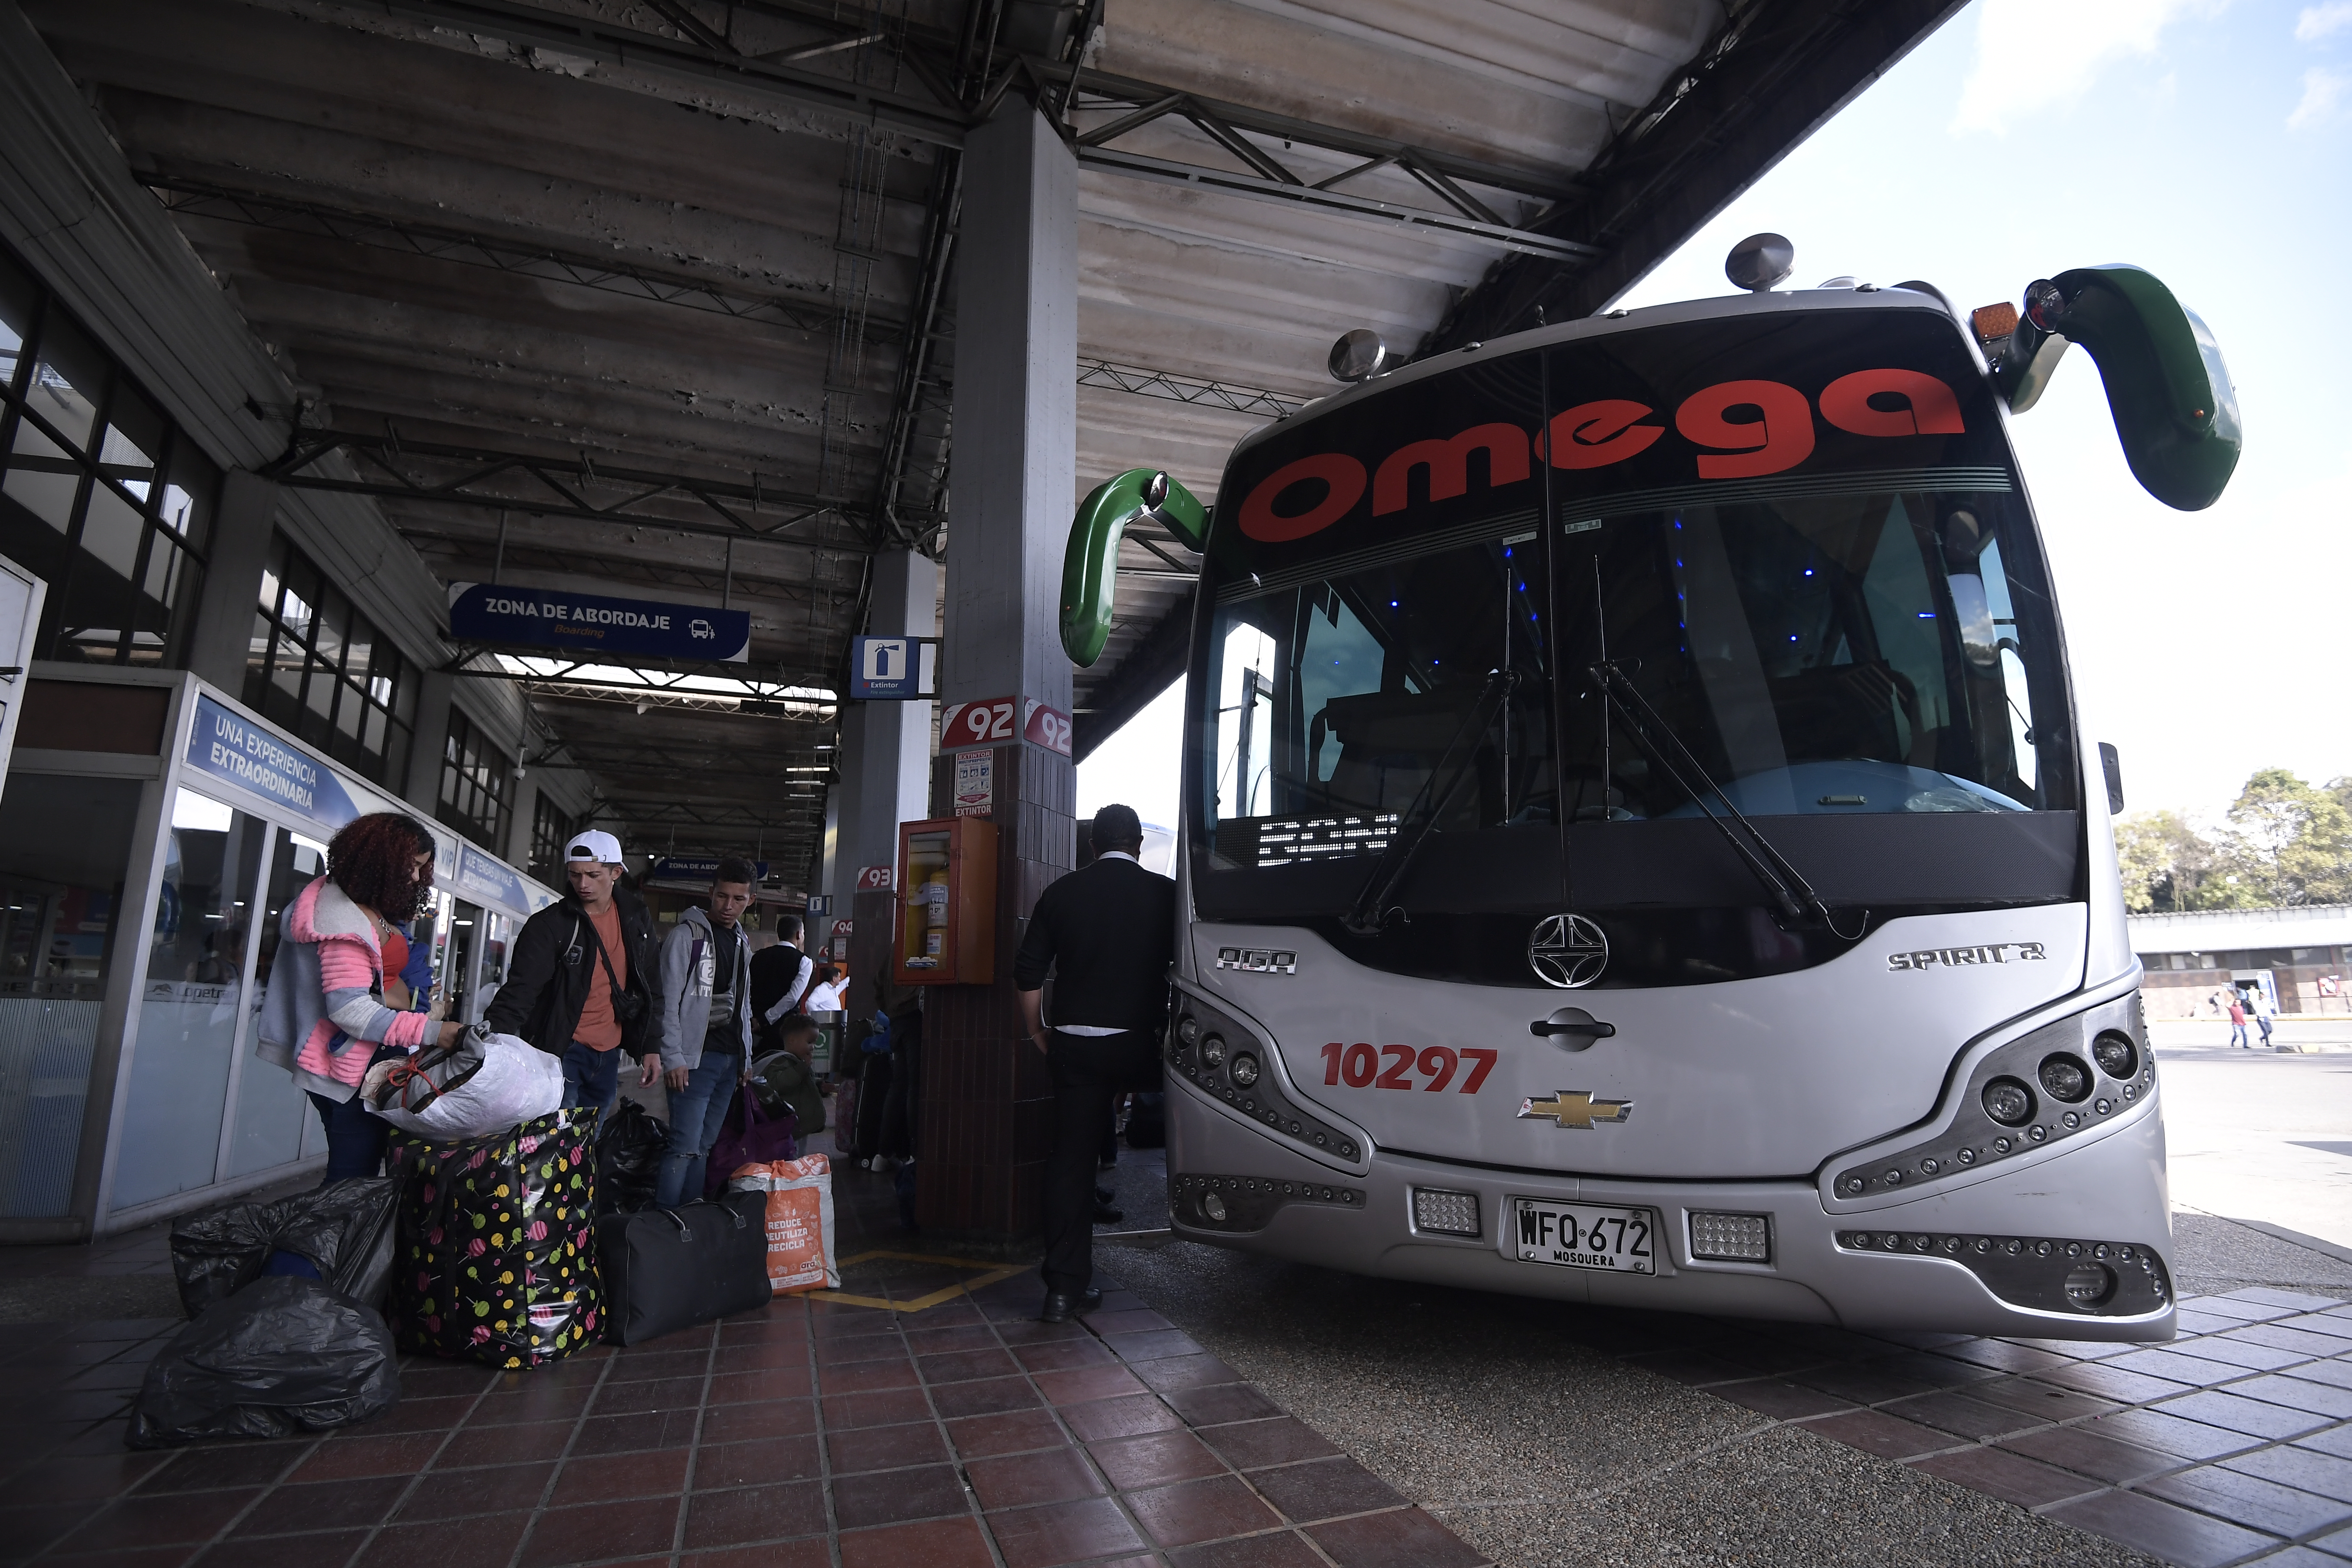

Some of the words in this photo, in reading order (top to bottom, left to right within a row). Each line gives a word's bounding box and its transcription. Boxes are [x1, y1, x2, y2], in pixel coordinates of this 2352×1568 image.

[1238, 368, 1965, 542] omega
[486, 598, 538, 616] ZONA
[543, 604, 567, 619] DE
[572, 607, 670, 630] ABORDAJE
[555, 624, 604, 638] Boarding
[967, 703, 1014, 740] 92
[1042, 712, 1071, 753] 92
[216, 715, 243, 748] UNA
[246, 733, 316, 787] EXPERIENCIA
[959, 751, 990, 760] EXTINTOR
[211, 742, 313, 809] EXTRAORDINARIA
[956, 805, 991, 817] EXTINTOR
[442, 847, 454, 867] VIP
[466, 853, 476, 868] QUE
[477, 859, 494, 877] TENGAS
[869, 868, 890, 887] 93
[838, 921, 852, 933] 94
[1216, 947, 1298, 975] AGA
[1887, 944, 2012, 972] SPIRIT
[1320, 1042, 1498, 1094] 10297
[768, 1218, 802, 1230] REDUCE
[768, 1239, 805, 1252] RECICLA
[801, 1260, 815, 1269] ara
[1553, 1250, 1614, 1267] MOSQUERA
